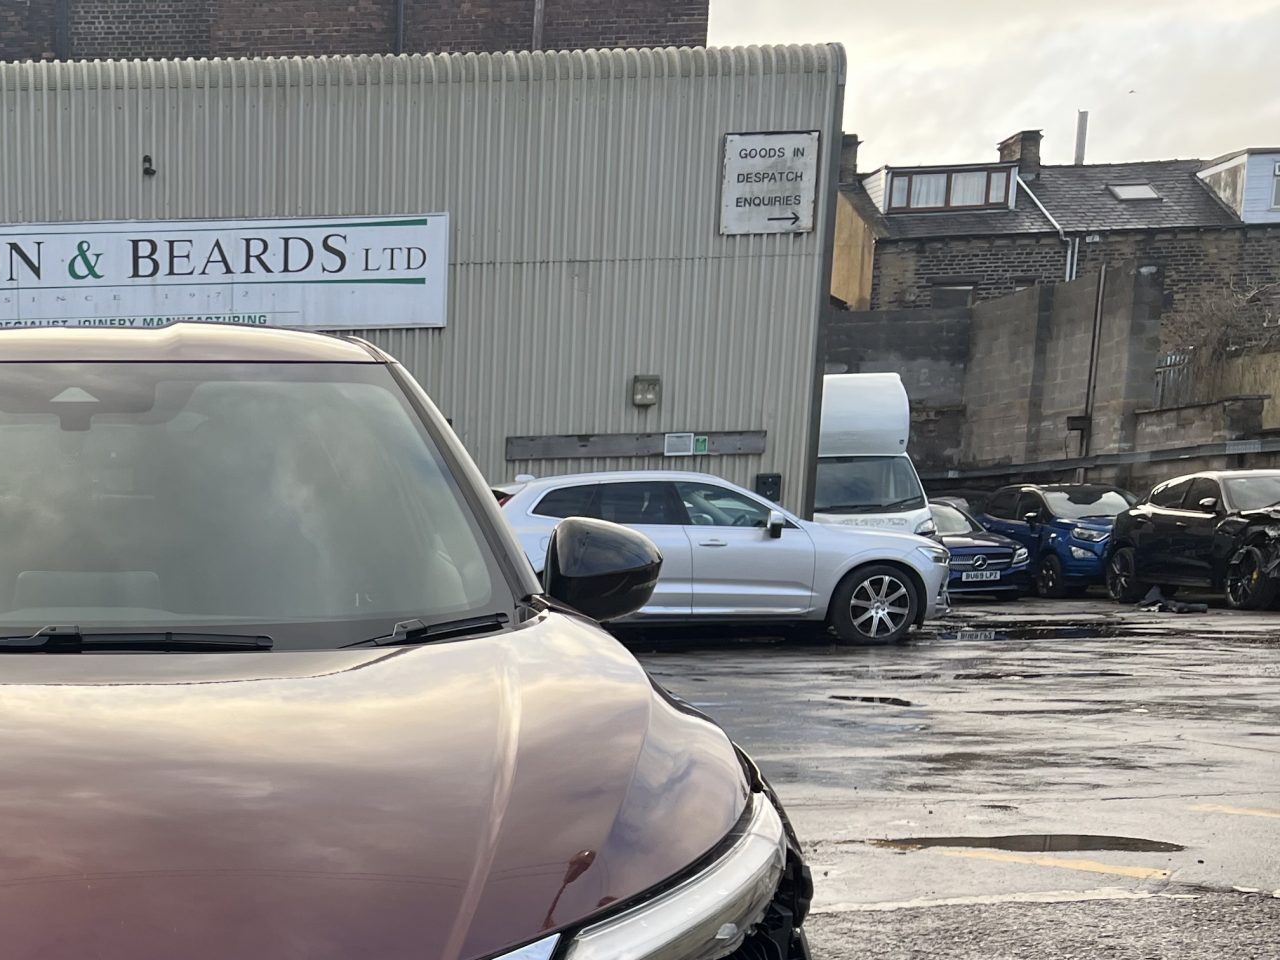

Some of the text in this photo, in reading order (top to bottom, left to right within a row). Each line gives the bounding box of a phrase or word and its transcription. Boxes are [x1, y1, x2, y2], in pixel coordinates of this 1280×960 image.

[738, 147, 805, 159] GOODS IN
[736, 171, 804, 184] DESPATCH
[735, 194, 802, 208] ENQUIRIES
[67, 240, 105, 280] &
[127, 233, 348, 279] BEARDS
[361, 246, 427, 272] LTD
[77, 317, 136, 326] JOINERY
